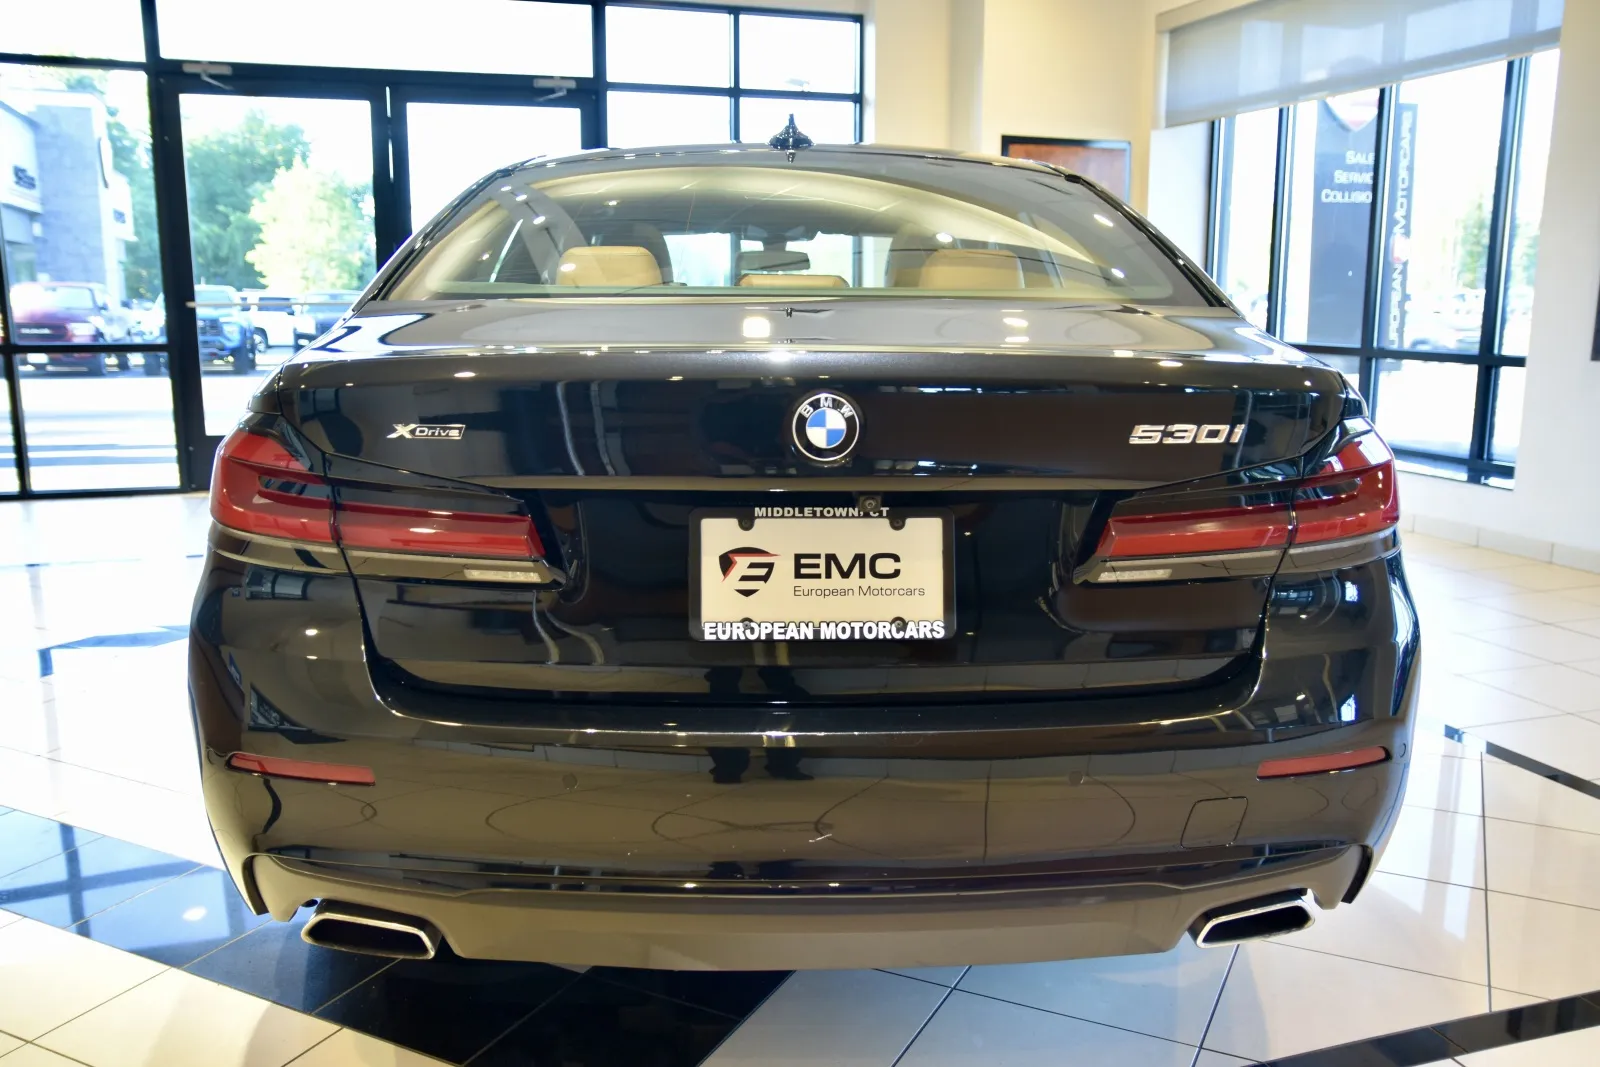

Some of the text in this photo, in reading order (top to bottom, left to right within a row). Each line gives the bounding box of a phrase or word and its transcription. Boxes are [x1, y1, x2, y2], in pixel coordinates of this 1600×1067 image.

[1345, 150, 1375, 165] SALE
[1334, 169, 1374, 184] SERVIC
[1321, 188, 1373, 204] COLLISIO
[1386, 263, 1403, 355] UROPEAN
[800, 396, 854, 418] BMW
[1129, 423, 1245, 444] 530i
[793, 552, 901, 579] EMC
[793, 585, 926, 598] European Motorcars
[703, 620, 946, 641] EUROPEAN MOTORCARS
